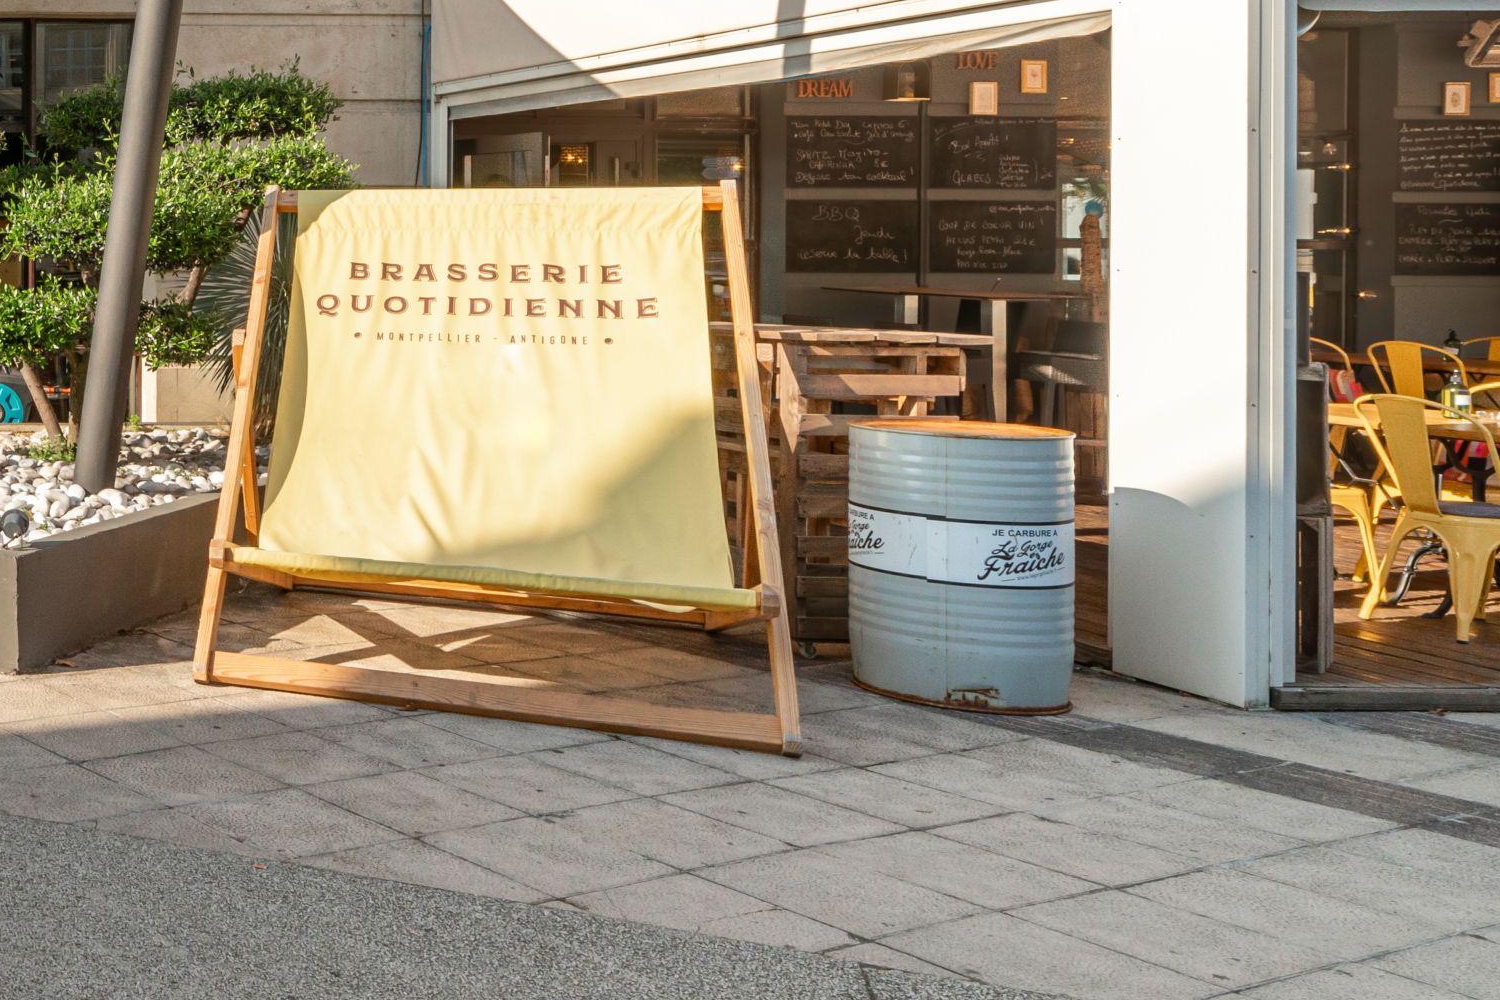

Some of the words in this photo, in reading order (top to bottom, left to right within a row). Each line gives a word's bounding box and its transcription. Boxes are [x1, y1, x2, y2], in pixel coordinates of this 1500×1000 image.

[956, 51, 997, 71] LOVE
[797, 79, 854, 98] DREAM
[348, 261, 623, 285] BRASSERIE
[316, 294, 660, 320] QUOTIDIENNE
[376, 332, 481, 343] MONTPELLIER
[510, 334, 588, 345] ANTIGONE
[992, 529, 1005, 537] JE
[1007, 529, 1052, 537] CARBURE
[991, 540, 1018, 560] La
[1017, 540, 1053, 558] Gorge
